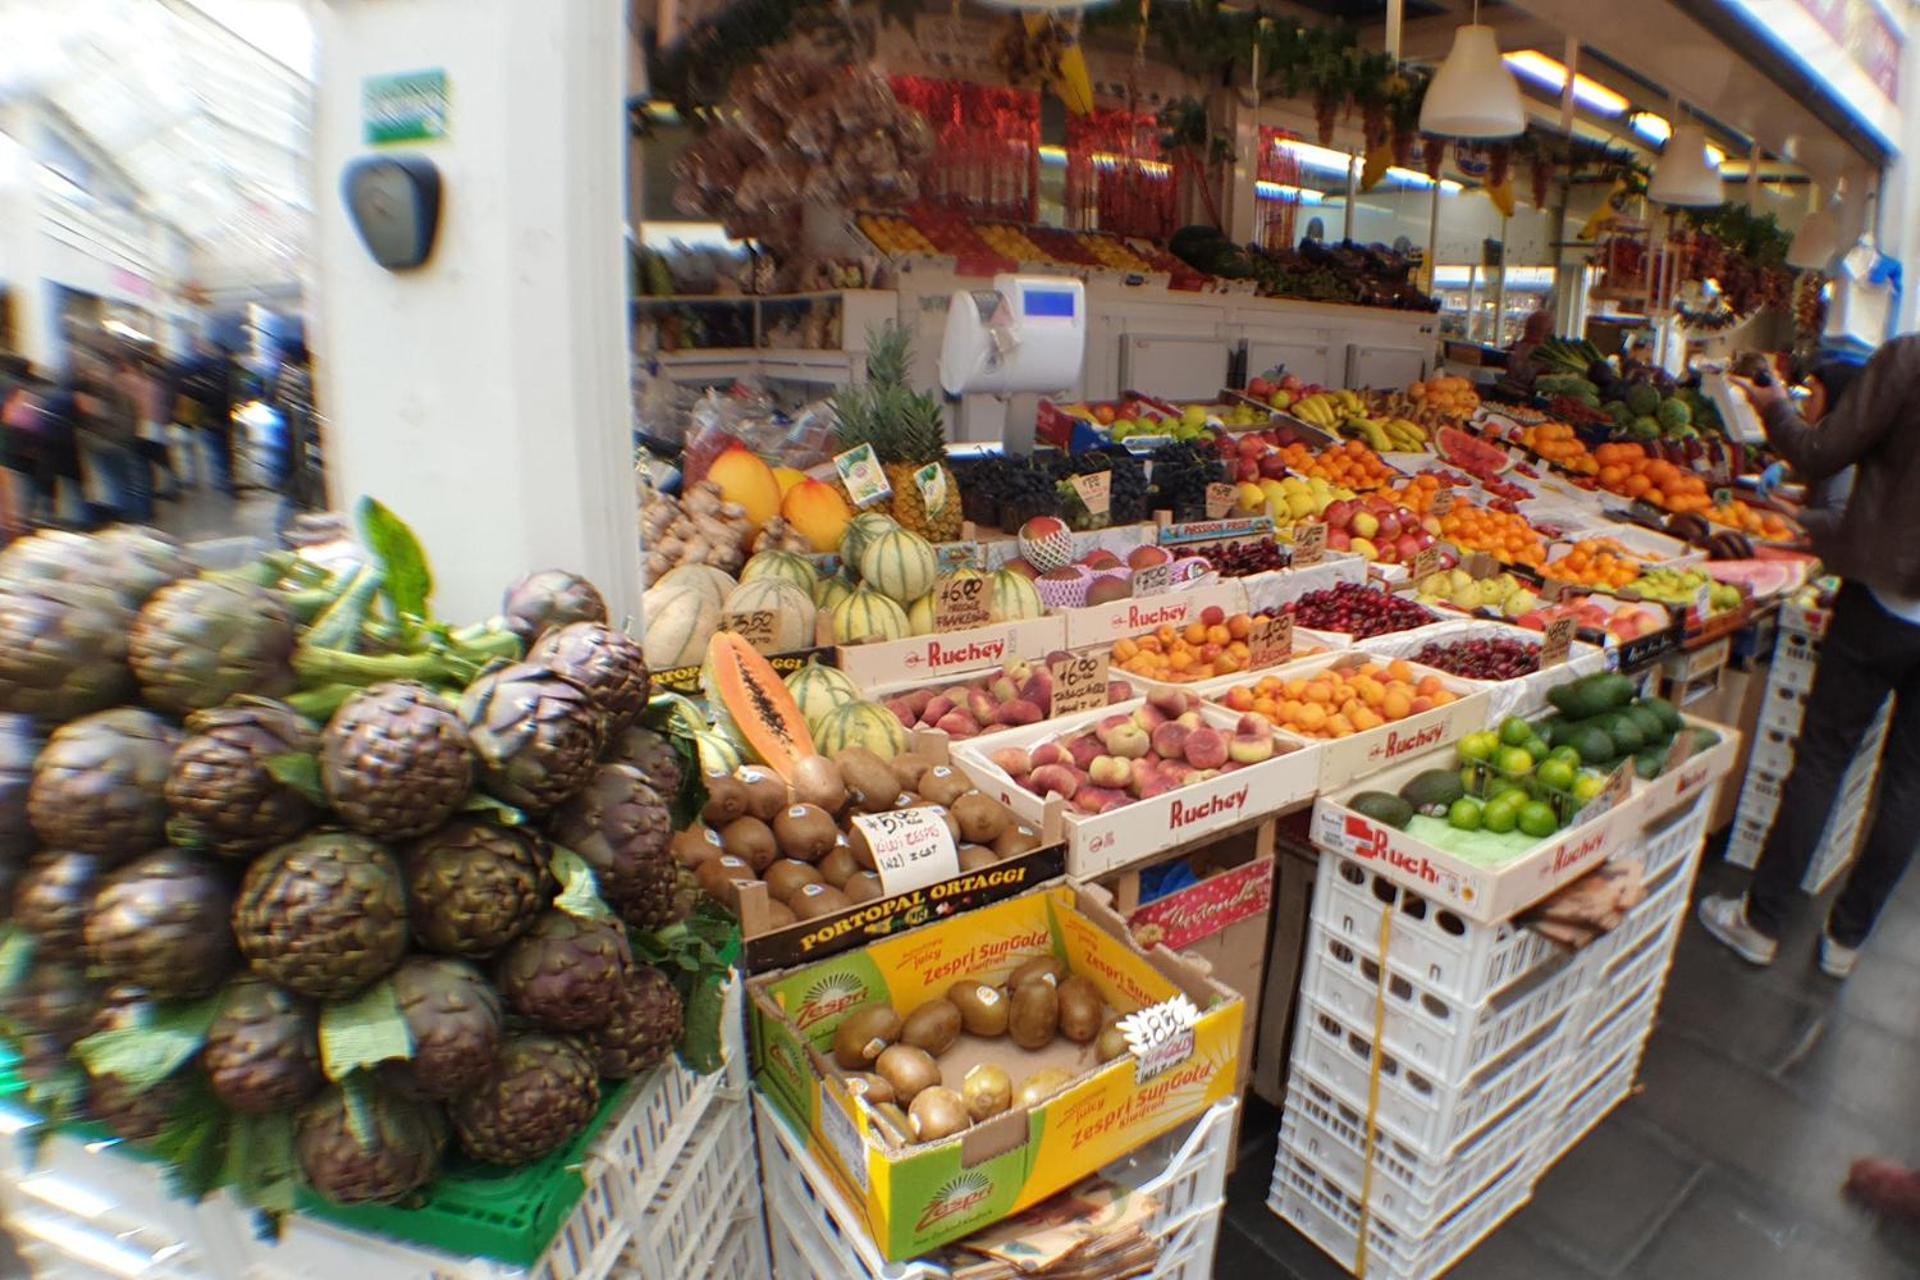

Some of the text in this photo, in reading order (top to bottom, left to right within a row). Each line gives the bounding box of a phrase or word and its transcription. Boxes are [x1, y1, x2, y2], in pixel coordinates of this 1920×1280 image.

[1129, 603, 1187, 629] Ruchey
[928, 639, 1005, 667] Ruchey
[1386, 721, 1445, 758] Ruchey
[1170, 783, 1248, 829] Ruchey
[1373, 829, 1440, 884] Ruch
[800, 892, 925, 950] PORTOPAL
[930, 867, 1026, 899] ORTAGGI
[923, 947, 975, 986] Zespri
[979, 931, 1049, 959] SunGold
[1086, 952, 1125, 983] Zespri
[796, 986, 868, 1030] Zespri
[1071, 1096, 1132, 1150] Zespri
[1136, 1061, 1212, 1107] SunGold
[914, 1183, 994, 1234] Zespri
